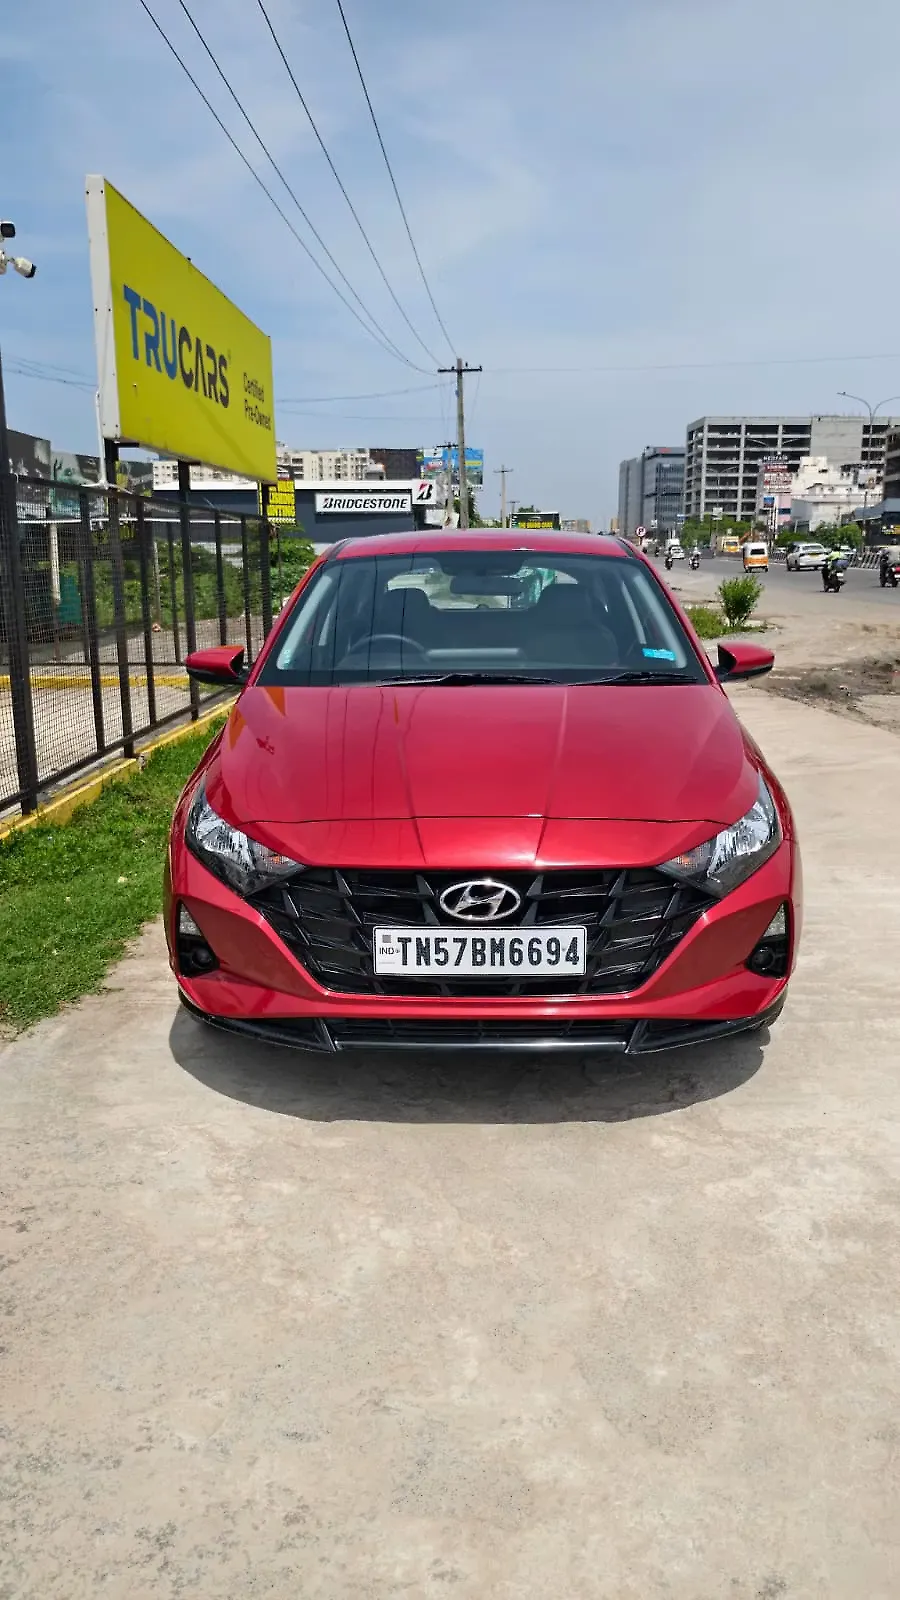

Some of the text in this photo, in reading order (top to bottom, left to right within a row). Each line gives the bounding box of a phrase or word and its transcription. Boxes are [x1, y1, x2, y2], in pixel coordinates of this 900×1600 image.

[123, 284, 229, 409] TRUCARS
[243, 372, 265, 403] Certified
[244, 399, 271, 430] Pre-Owned
[322, 497, 408, 509] BRIDGESTONE
[379, 947, 394, 955] IND
[397, 936, 580, 967] TN57BM6694
